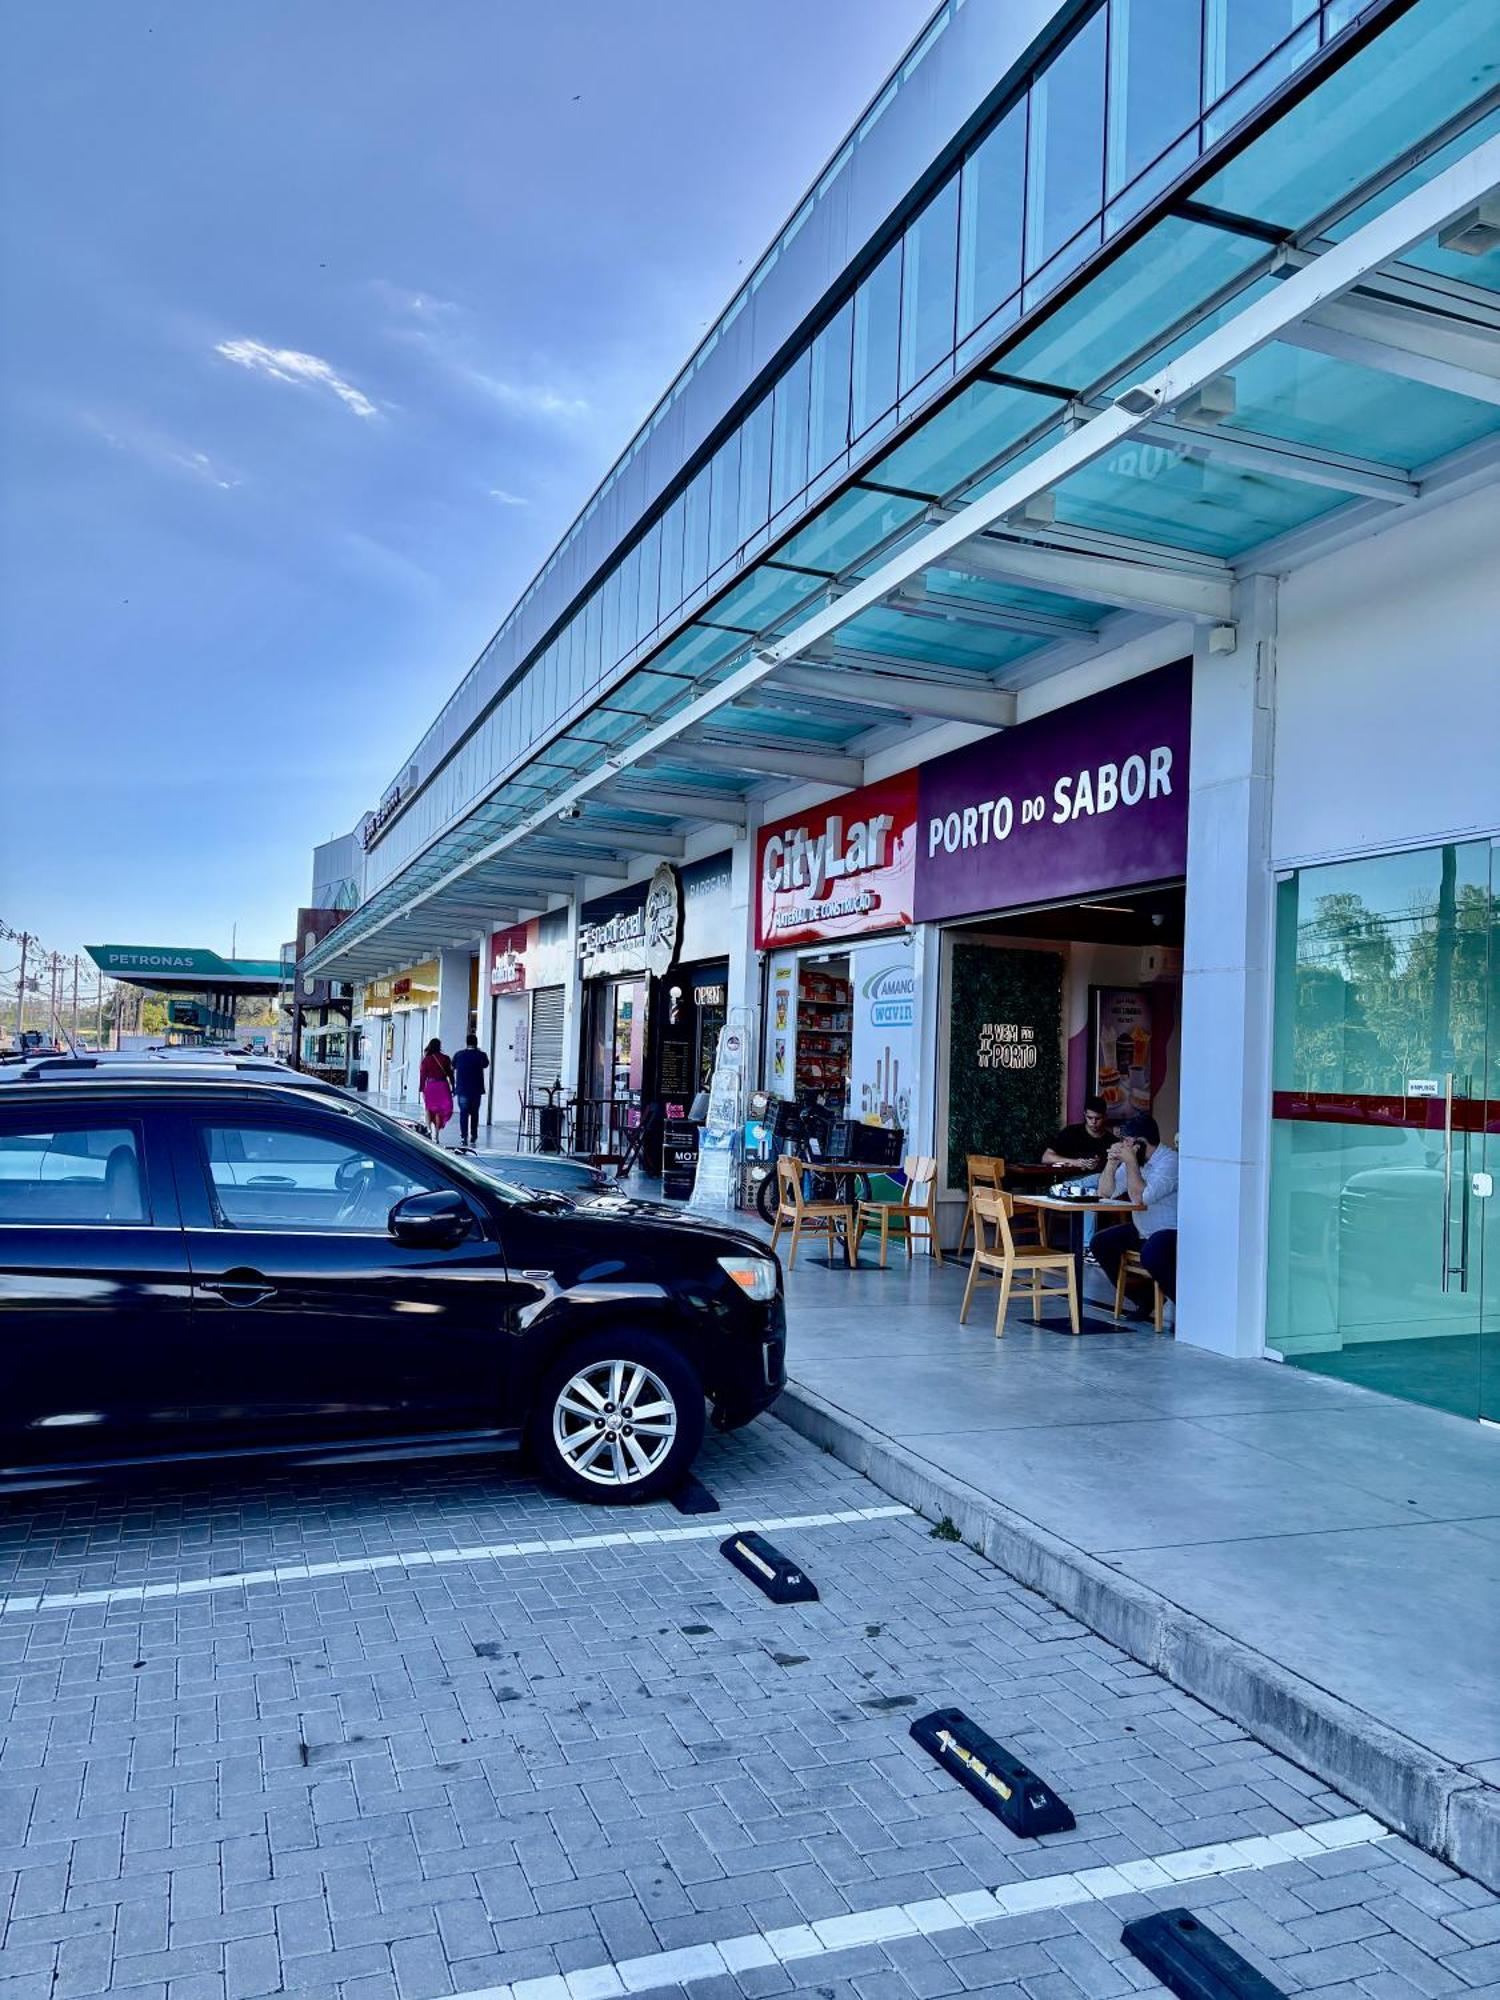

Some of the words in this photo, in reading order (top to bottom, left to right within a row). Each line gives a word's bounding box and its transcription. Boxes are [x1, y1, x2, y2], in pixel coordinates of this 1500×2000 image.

[928, 796, 1013, 858] PORTO
[1021, 795, 1045, 825] DO
[1052, 746, 1173, 824] SABOR
[763, 814, 894, 899] CityLar
[690, 872, 733, 897] BARBEARI
[775, 907, 809, 928] MATERIAL
[109, 953, 194, 967] PETRONAS
[694, 985, 721, 1006] OPEN
[875, 1005, 912, 1022] wavin
[992, 1043, 1037, 1068] PORTO
